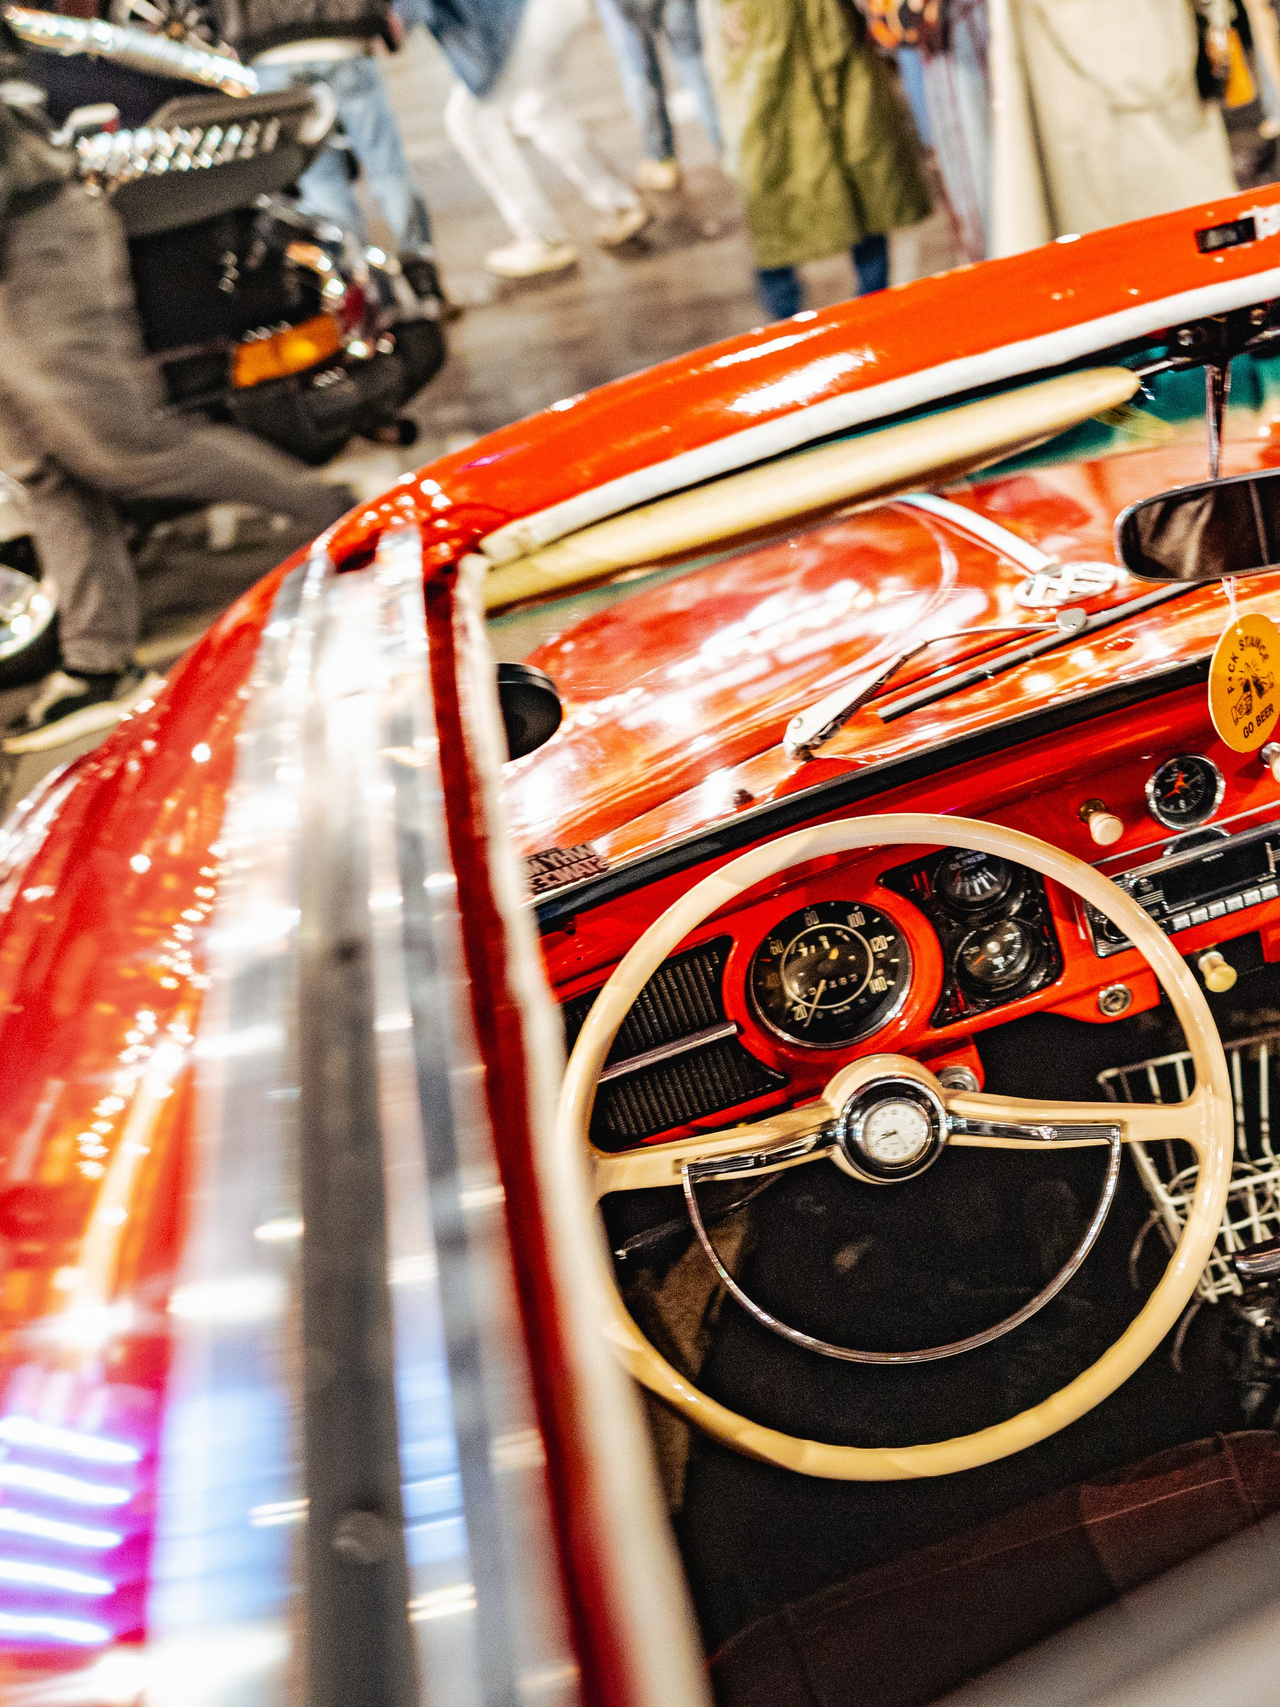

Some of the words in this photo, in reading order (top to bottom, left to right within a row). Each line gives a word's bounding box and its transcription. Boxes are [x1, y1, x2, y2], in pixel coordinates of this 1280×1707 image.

[1238, 635, 1269, 662] STANCE
[1243, 721, 1254, 739] GO
[1255, 703, 1275, 727] BEER
[846, 911, 866, 928] 100
[769, 939, 784, 955] 60
[869, 935, 889, 953] 120
[868, 976, 888, 994] 140
[791, 1004, 808, 1021] 20
